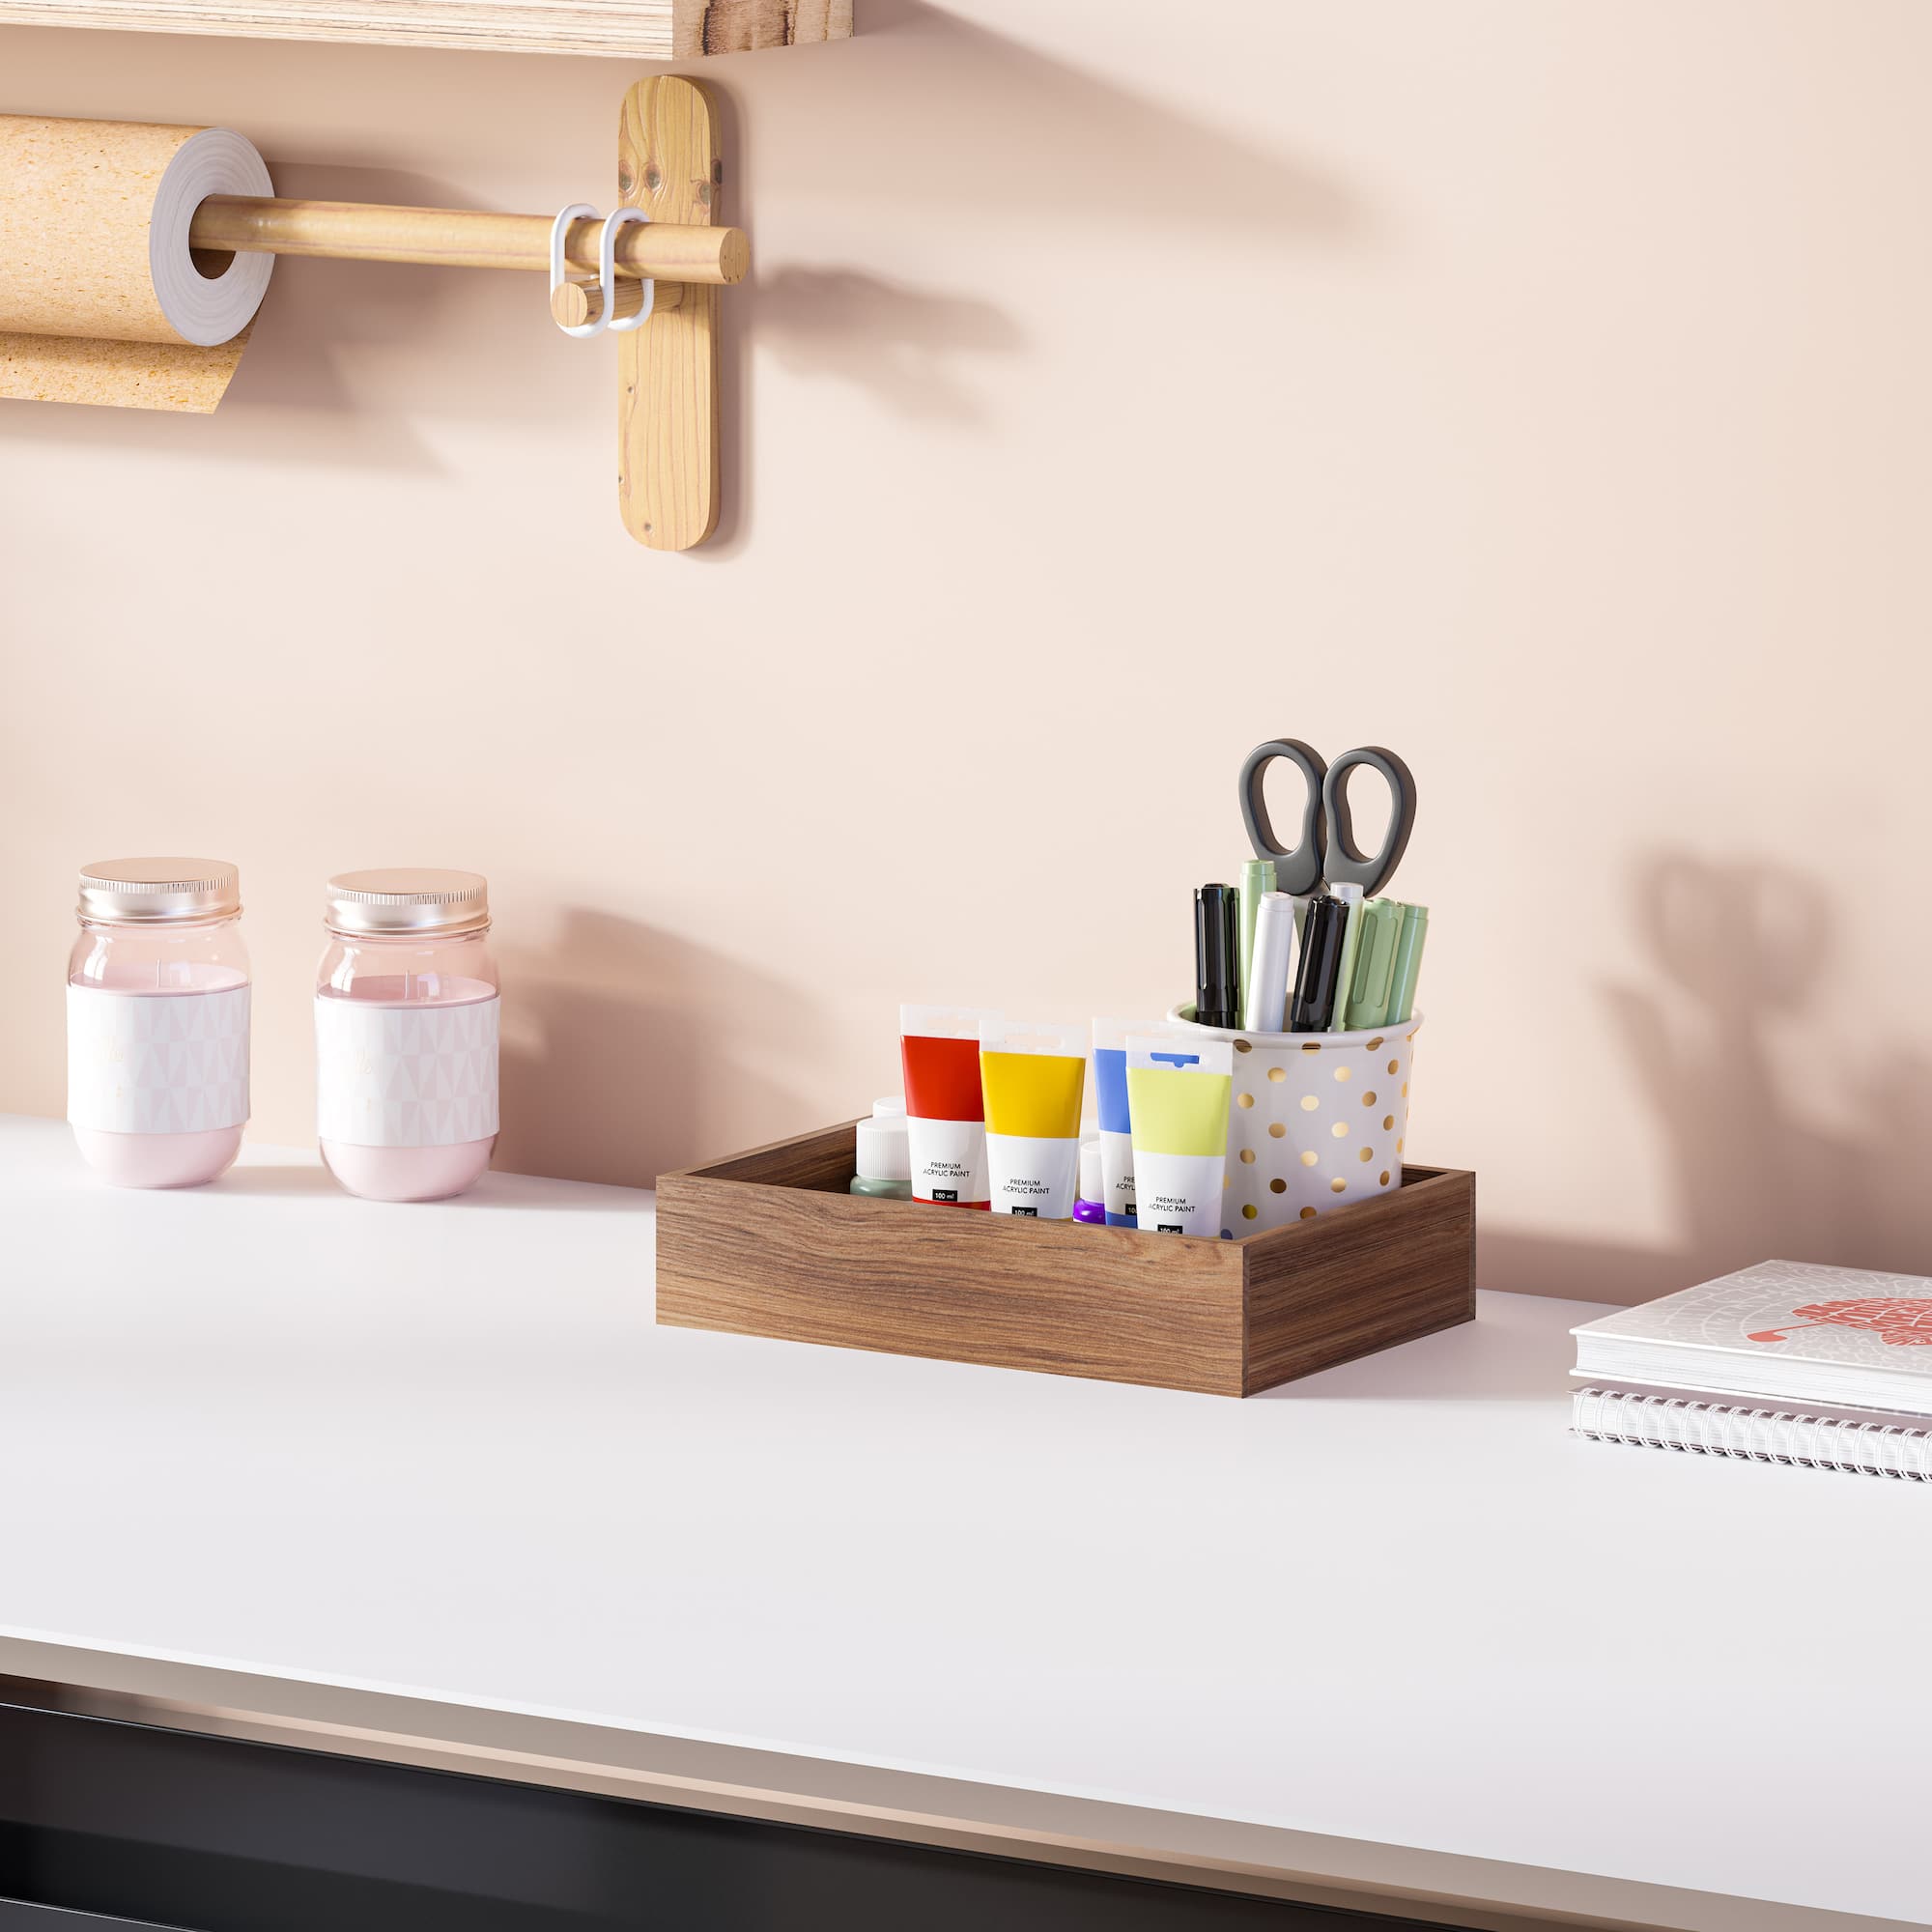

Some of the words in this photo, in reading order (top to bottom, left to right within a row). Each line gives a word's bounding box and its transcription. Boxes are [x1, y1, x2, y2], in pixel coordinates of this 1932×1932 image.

[930, 1161, 961, 1170] PREMIUM
[923, 1168, 949, 1177] ACRYLIC
[1009, 1178, 1040, 1186] PREMIUM
[1002, 1185, 1028, 1194] ACRYLIC
[1155, 1196, 1186, 1205] PREMIUM
[1148, 1203, 1174, 1212] ACRYLIC
